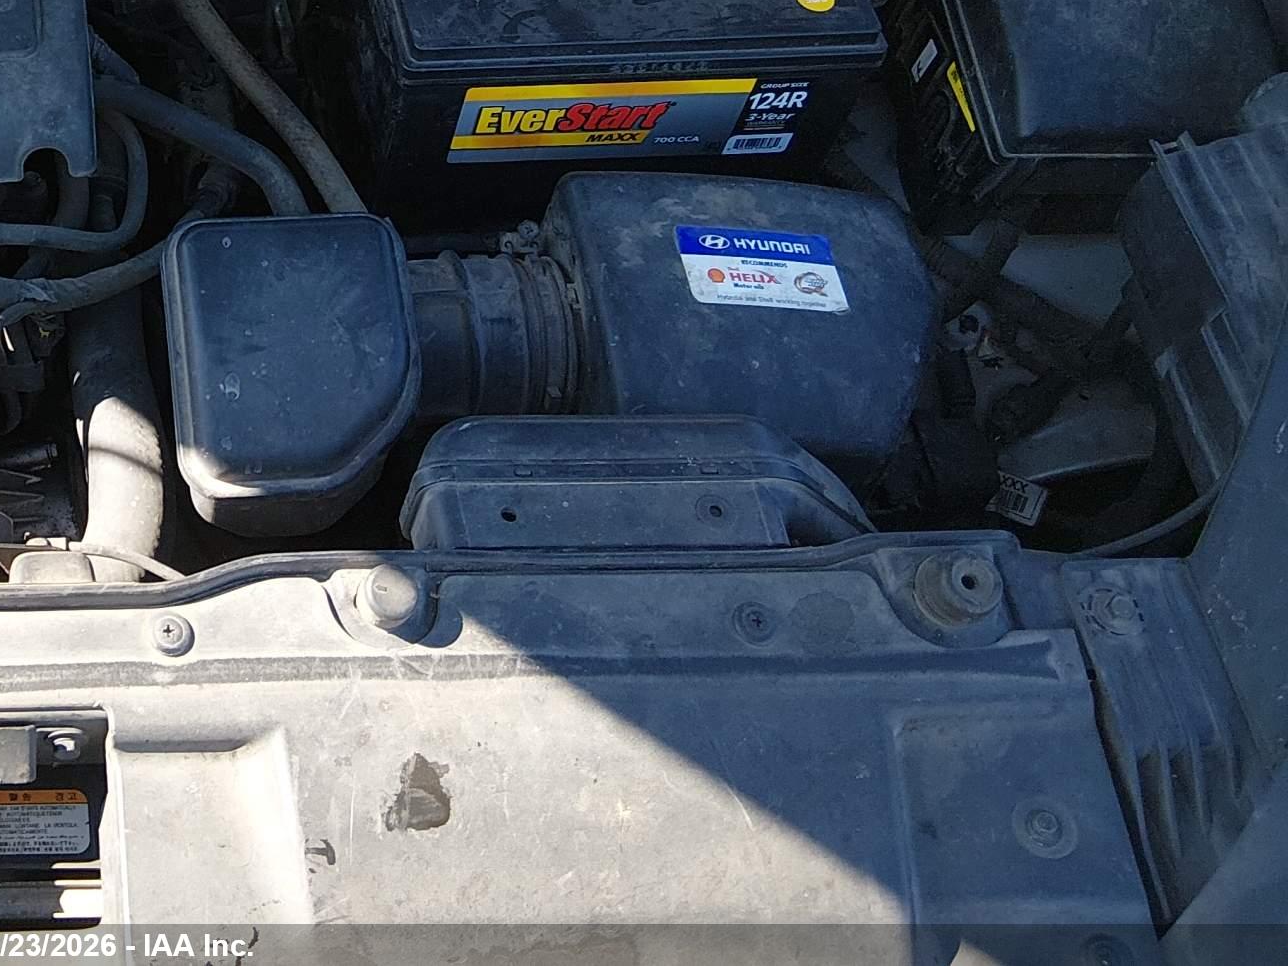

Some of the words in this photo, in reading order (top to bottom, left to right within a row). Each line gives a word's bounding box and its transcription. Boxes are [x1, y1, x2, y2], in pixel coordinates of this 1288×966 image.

[749, 91, 808, 110] 124R
[474, 101, 673, 134] EverStart
[746, 113, 795, 121] 3-Year
[585, 132, 639, 143] MAXX
[653, 136, 675, 144] 700
[733, 237, 811, 255] HYUNDAI
[741, 259, 788, 269] RECOMMENDS
[729, 271, 780, 284] HELIX
